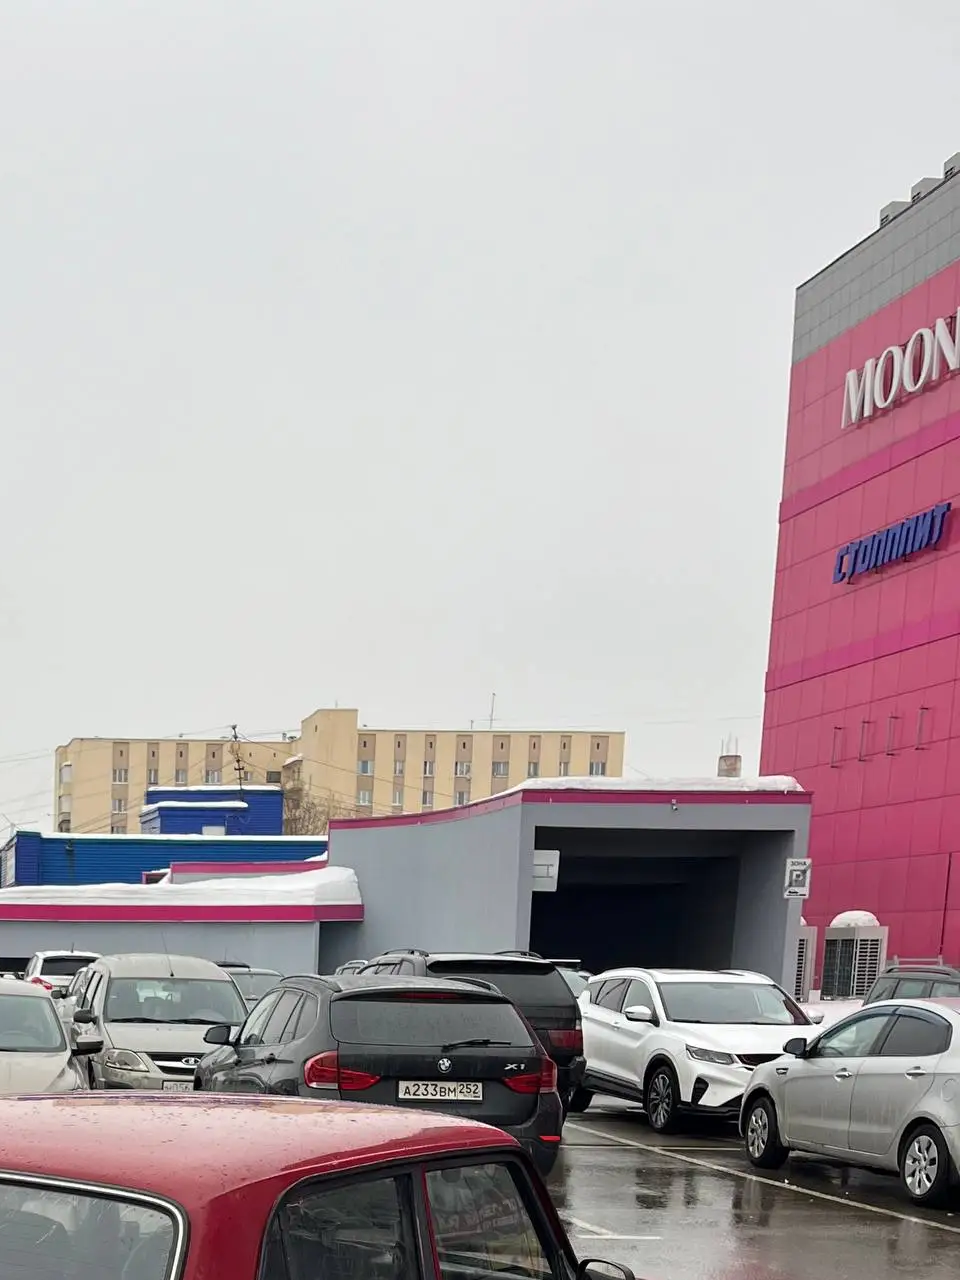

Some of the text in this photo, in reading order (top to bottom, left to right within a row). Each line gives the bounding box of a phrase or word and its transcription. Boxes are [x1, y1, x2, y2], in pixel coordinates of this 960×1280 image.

[841, 306, 960, 429] MOON
[504, 1063, 525, 1071] X1
[403, 1083, 479, 1097] А233ВМ 252
